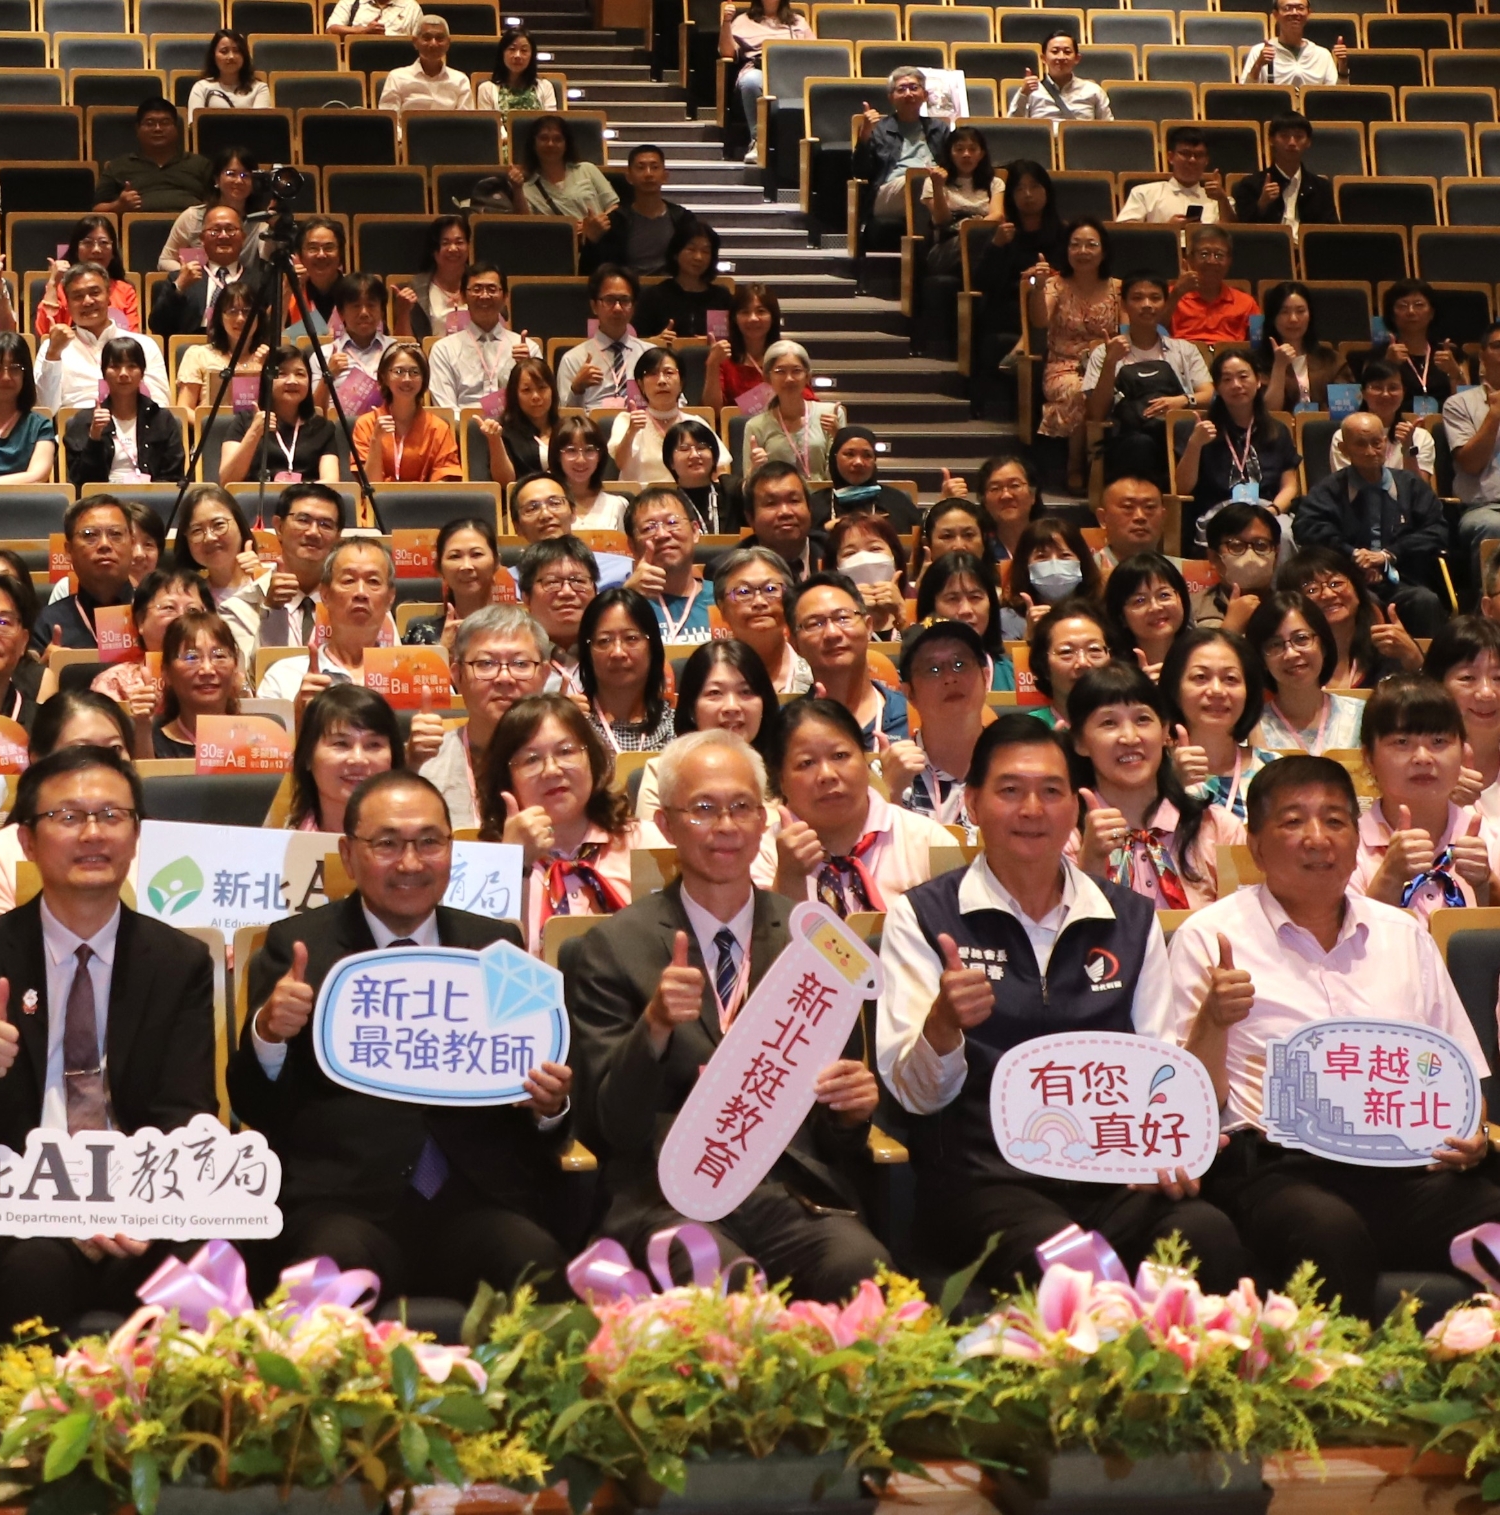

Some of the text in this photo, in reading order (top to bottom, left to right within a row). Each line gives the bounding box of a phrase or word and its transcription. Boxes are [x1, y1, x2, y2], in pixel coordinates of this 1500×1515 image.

[1018, 671, 1037, 685] 30
[200, 743, 224, 759] 30年
[225, 750, 246, 768] A組
[350, 974, 470, 1022] 新北
[349, 1025, 535, 1077] 最強教師
[1322, 1042, 1411, 1084] 卓越
[693, 971, 839, 1188] 新北挺教育
[1029, 1060, 1130, 1106] 有您
[1363, 1087, 1452, 1130] 新北
[1089, 1112, 1190, 1158] 真好
[6, 1211, 87, 1225] Department,
[90, 1213, 118, 1225] New
[121, 1213, 159, 1227] Taipei
[162, 1214, 187, 1228] City
[190, 1214, 269, 1226] Government
